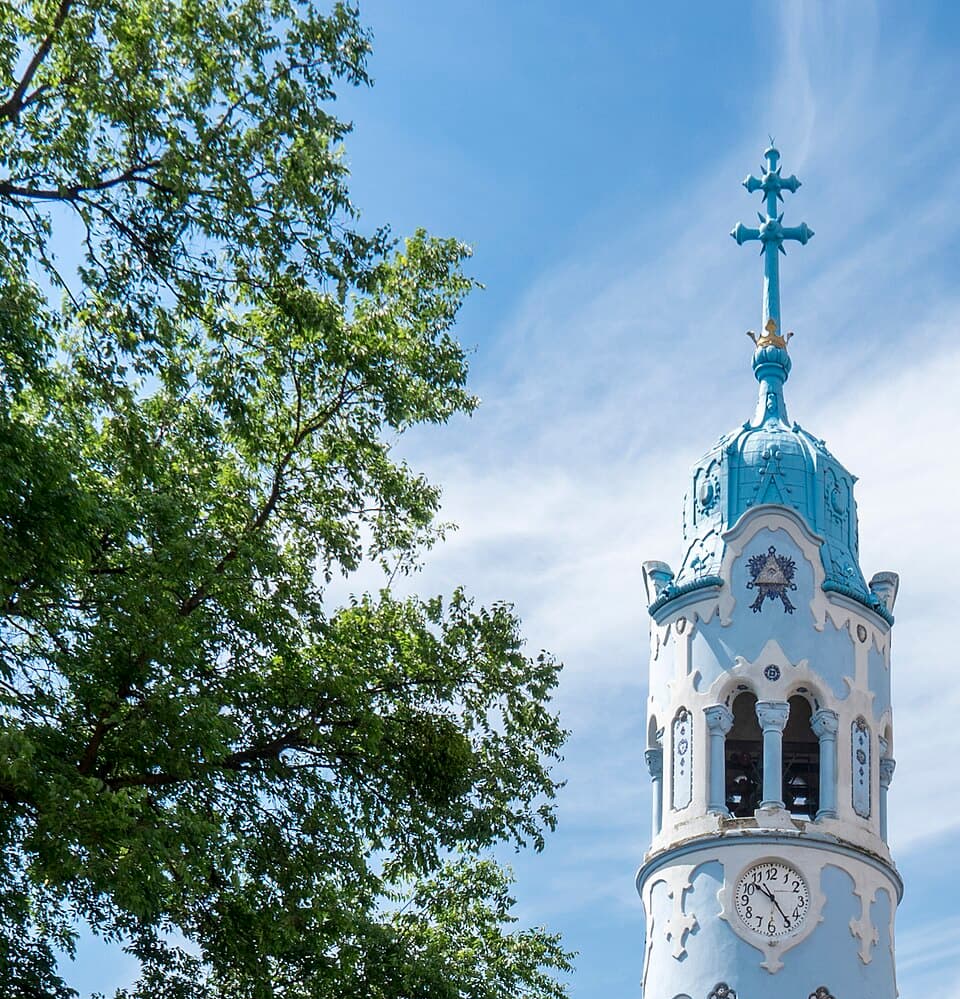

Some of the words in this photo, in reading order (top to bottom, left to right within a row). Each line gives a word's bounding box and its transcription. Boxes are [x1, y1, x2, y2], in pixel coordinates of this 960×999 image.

[752, 872, 762, 883] 11
[766, 868, 777, 880] 12
[783, 874, 789, 884] 1
[744, 883, 755, 895] 10
[792, 881, 800, 893] 2
[741, 895, 749, 906] 9
[797, 896, 805, 907] 3
[745, 906, 753, 918] 8
[792, 907, 800, 921] 4
[756, 916, 763, 927] 7
[768, 919, 776, 933] 6
